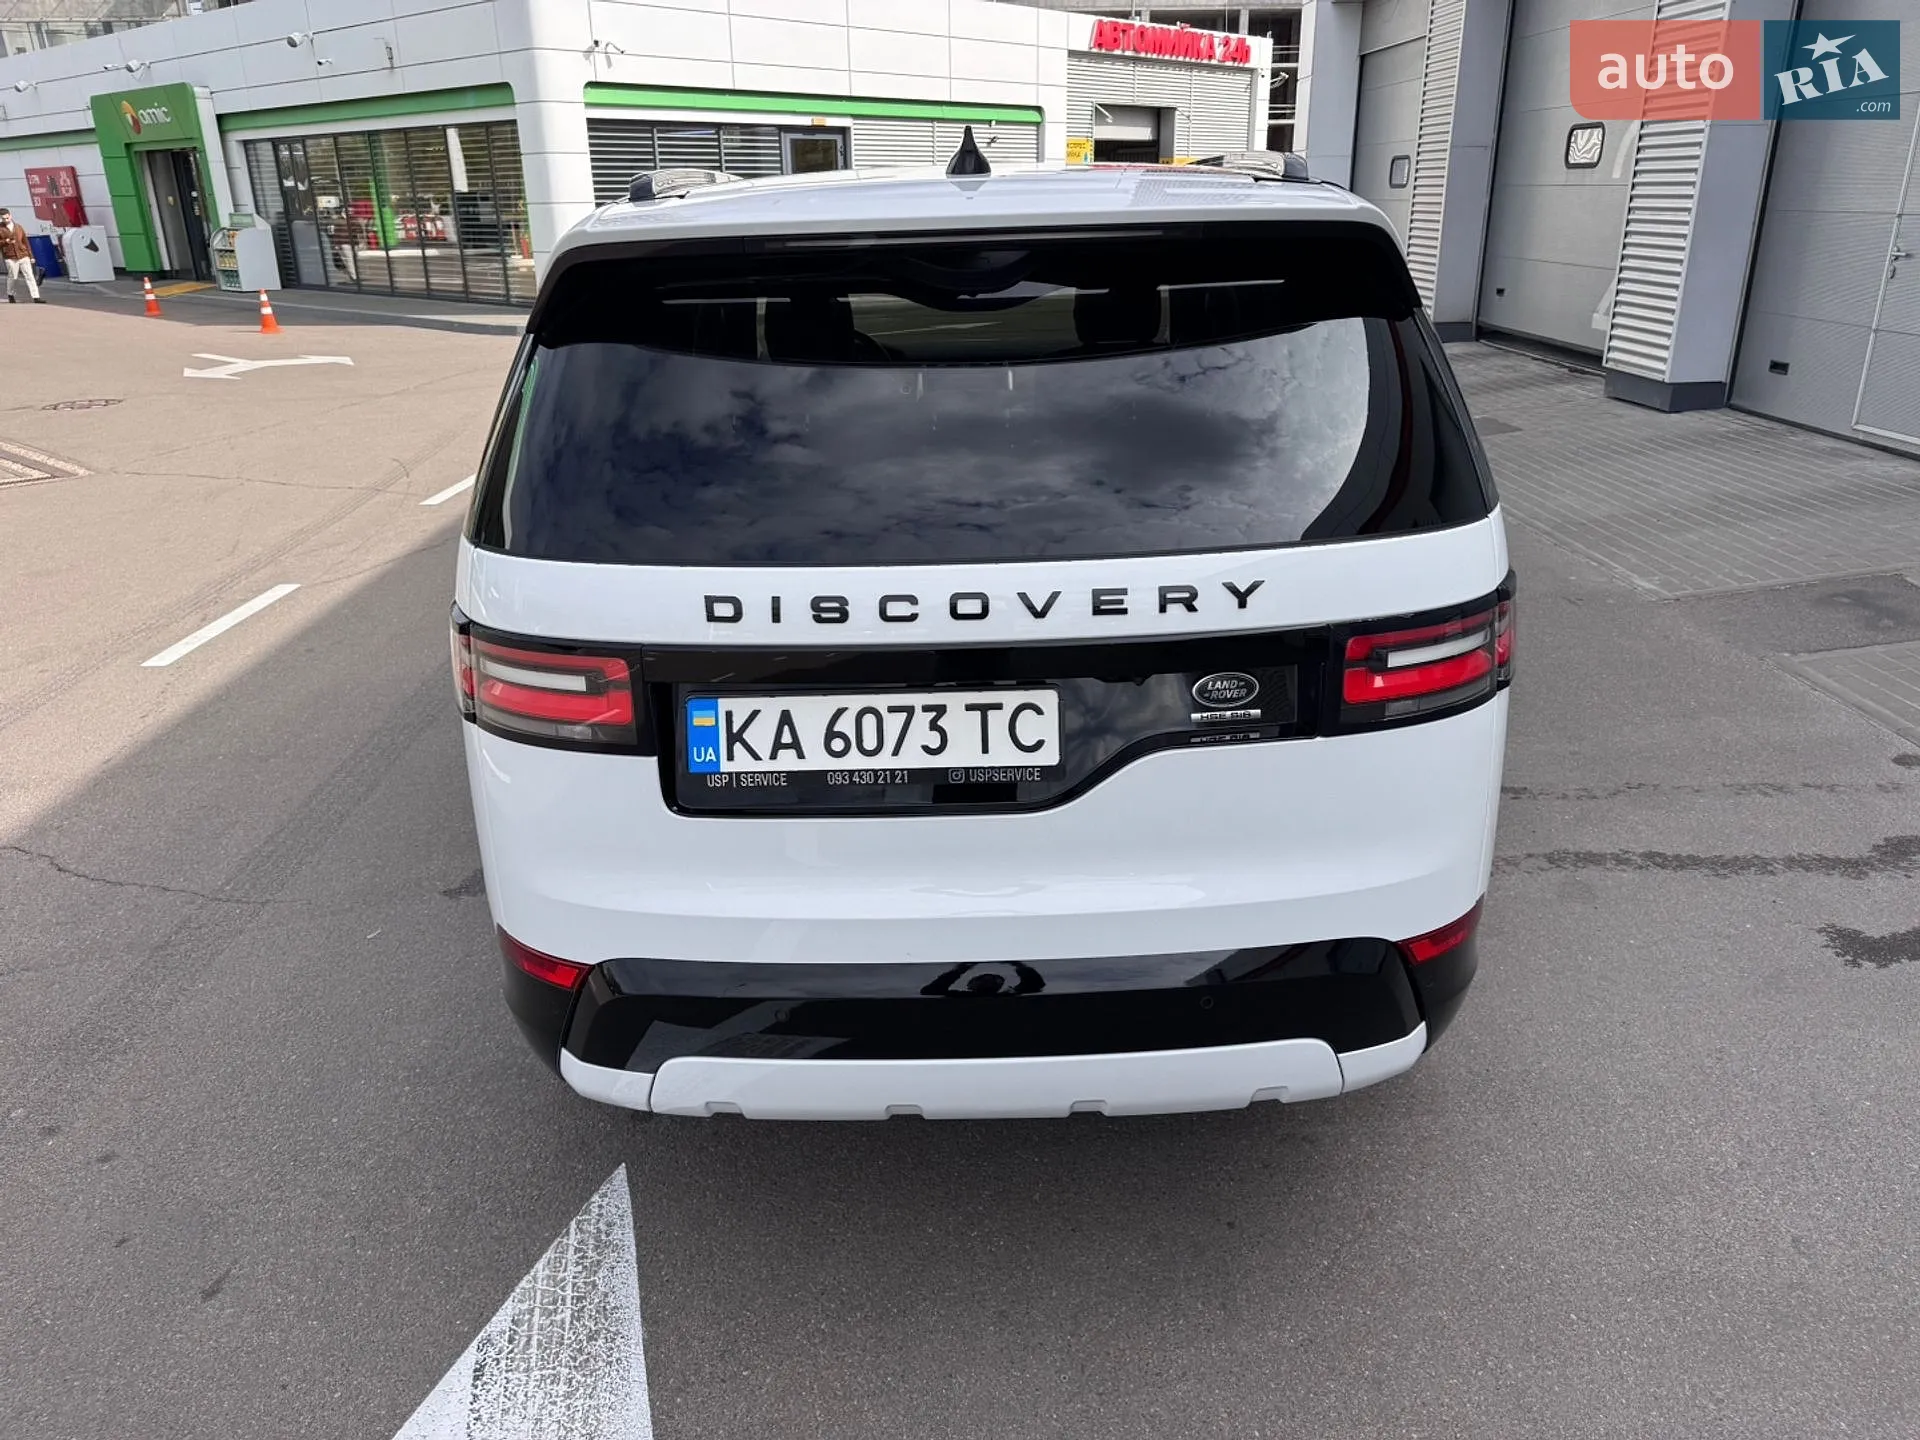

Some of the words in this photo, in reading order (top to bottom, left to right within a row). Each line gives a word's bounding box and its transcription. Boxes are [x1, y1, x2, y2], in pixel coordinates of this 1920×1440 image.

[703, 579, 1266, 625] DISCOVERY
[724, 708, 807, 762] KA
[823, 705, 949, 759] 6073
[964, 701, 1046, 755] TC
[693, 747, 717, 764] UA
[706, 774, 729, 787] USP
[740, 772, 788, 787] SERVICE
[826, 771, 850, 785] 093
[852, 770, 875, 784] 430
[877, 770, 891, 784] 21
[894, 769, 909, 784] 21
[969, 767, 1042, 782] USPSERVICE
